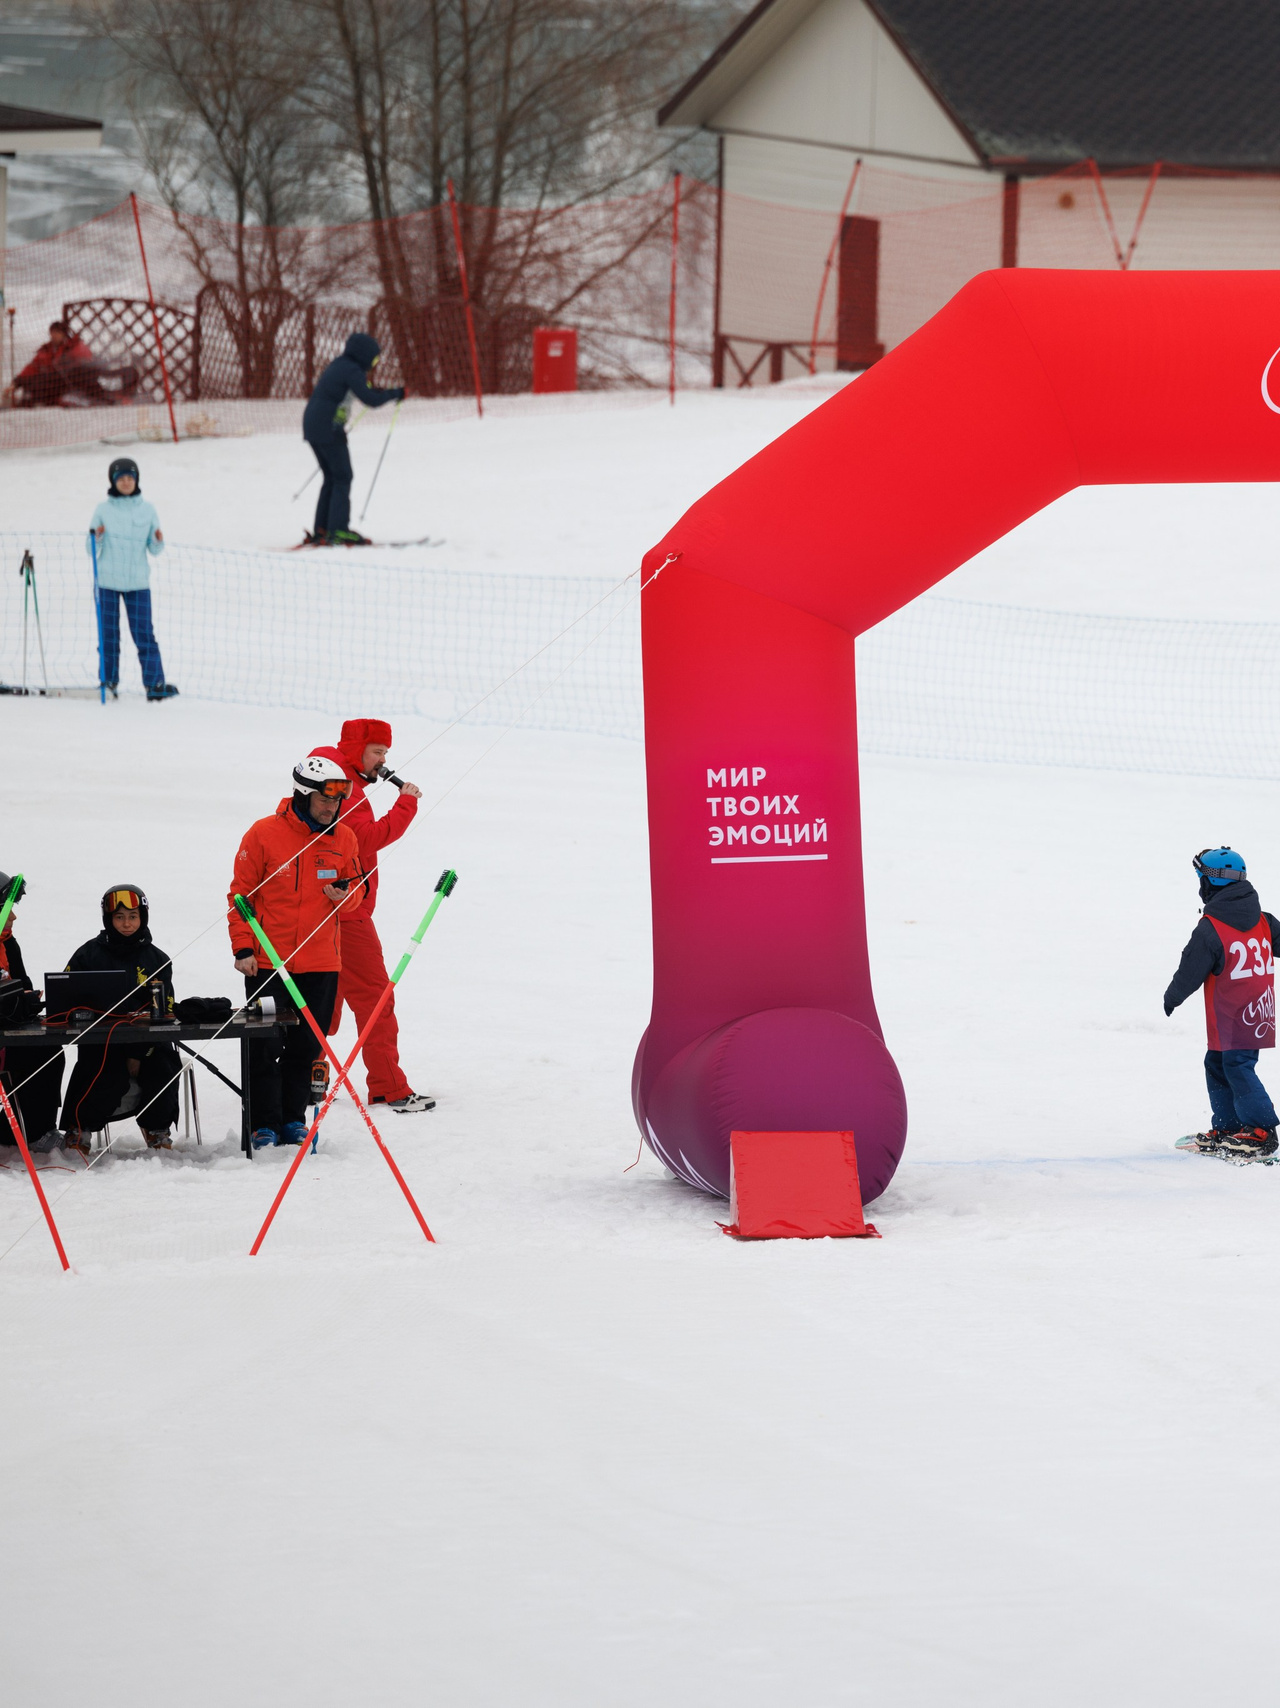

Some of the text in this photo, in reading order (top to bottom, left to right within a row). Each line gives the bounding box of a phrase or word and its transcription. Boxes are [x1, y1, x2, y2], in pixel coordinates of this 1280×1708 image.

[706, 766, 766, 788] МИР
[706, 795, 800, 817] ТВОИХ
[708, 818, 828, 847] ЭМОЦИЙ
[1229, 937, 1275, 980] 232
